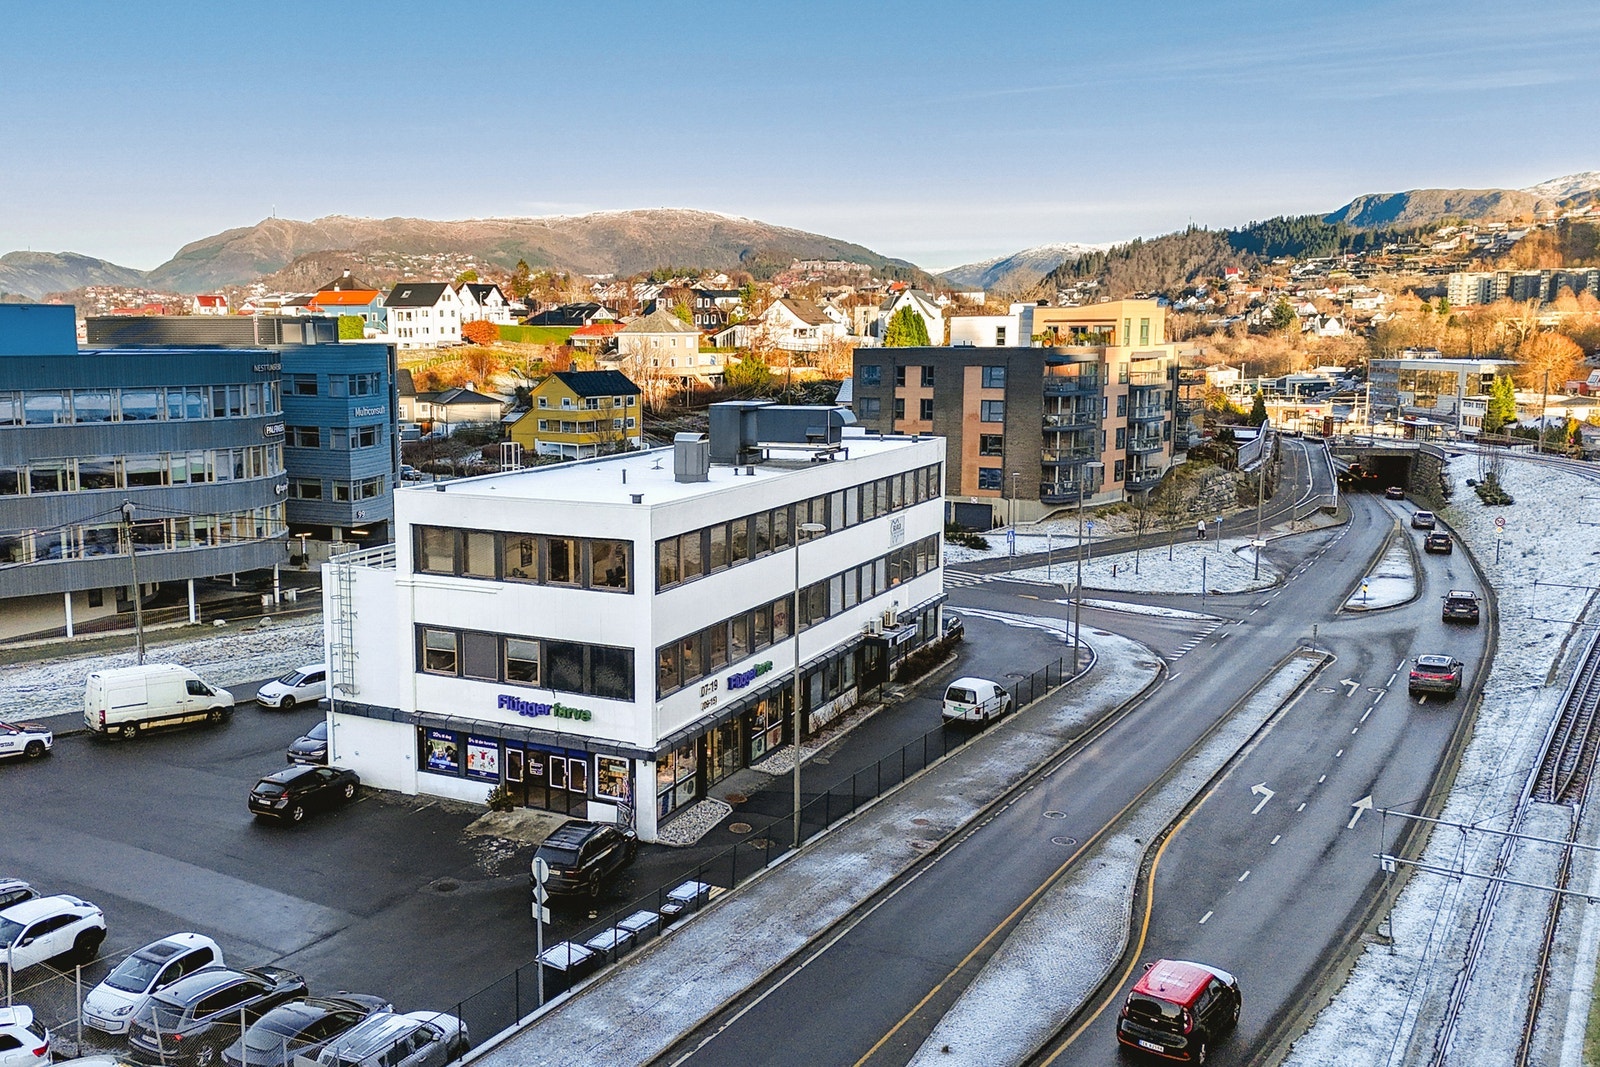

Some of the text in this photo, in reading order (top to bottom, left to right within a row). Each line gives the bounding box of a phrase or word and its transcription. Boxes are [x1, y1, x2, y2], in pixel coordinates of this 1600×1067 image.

[355, 405, 386, 417] Multiconsult
[700, 679, 718, 697] 07-19
[728, 668, 757, 690] Flügger
[498, 694, 592, 721] Flügger farve
